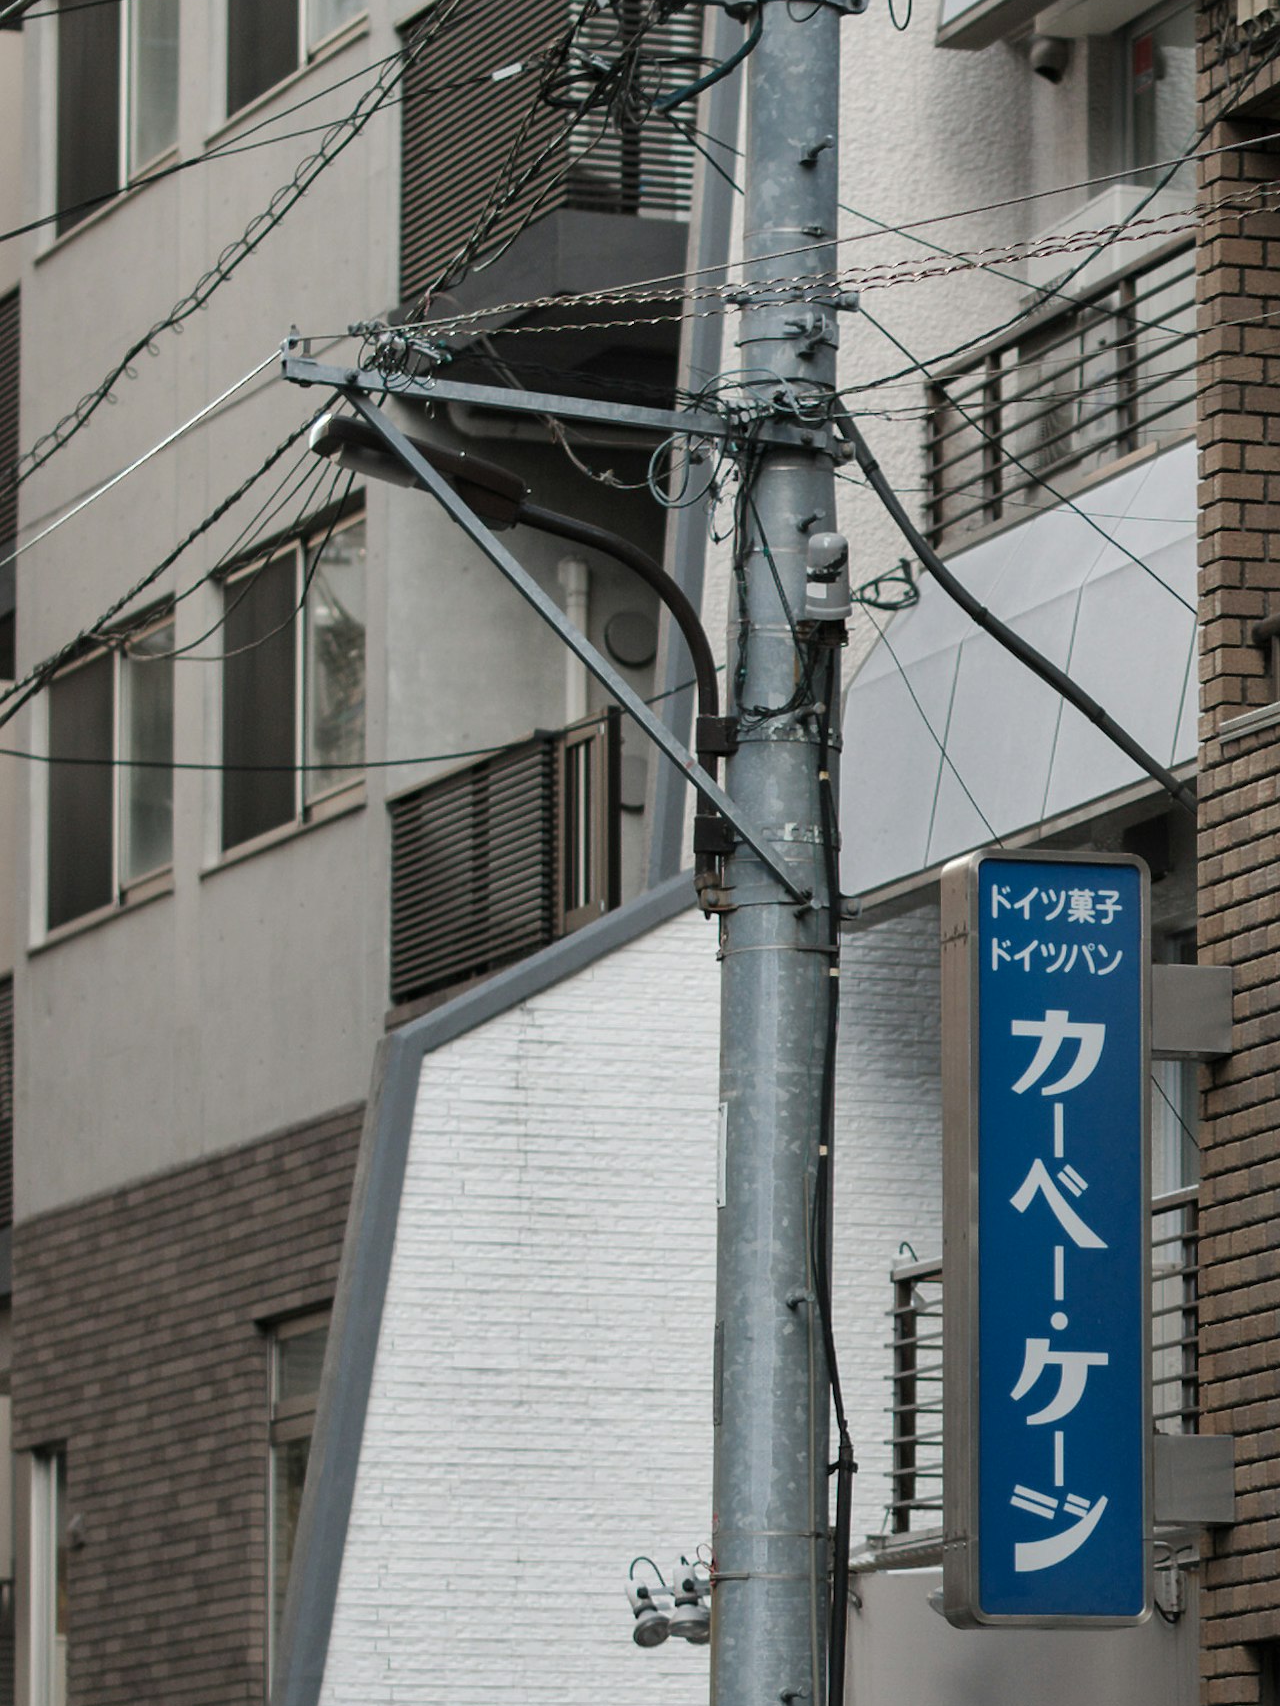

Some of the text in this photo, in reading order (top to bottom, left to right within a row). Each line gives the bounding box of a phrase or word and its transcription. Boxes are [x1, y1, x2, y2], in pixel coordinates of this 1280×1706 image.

[990, 884, 1123, 926] ドイツ菓子
[990, 938, 1123, 977] ドイツパン
[1009, 1009, 1109, 1572] カーベー・ケージ
